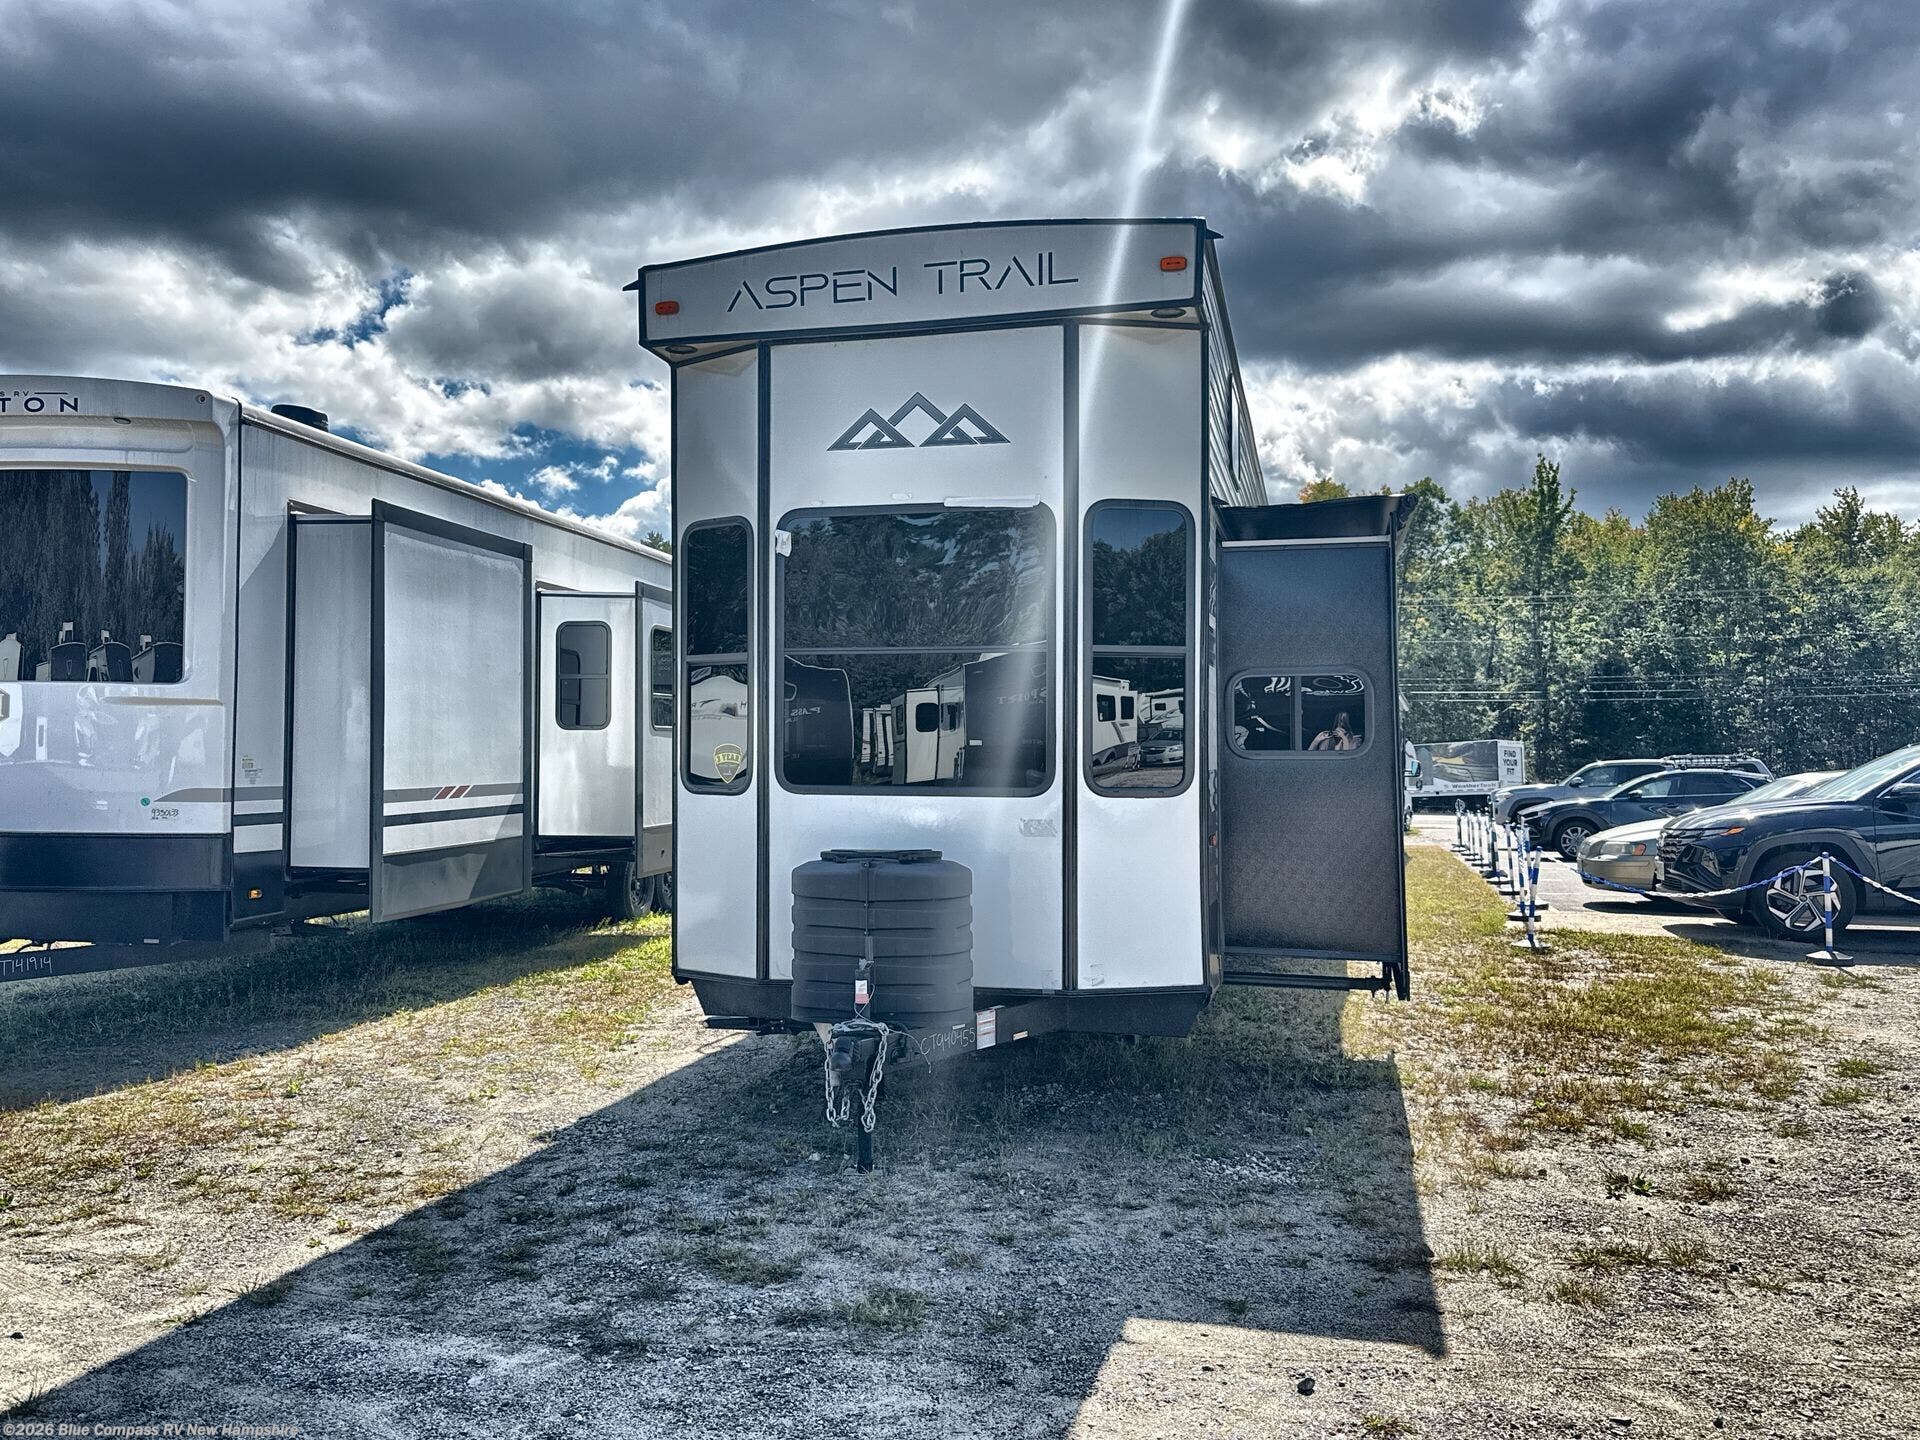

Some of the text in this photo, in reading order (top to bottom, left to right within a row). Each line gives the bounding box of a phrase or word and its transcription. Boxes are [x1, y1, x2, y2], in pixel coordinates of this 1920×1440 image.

[727, 251, 1079, 313] ASPEN TRAIL
[722, 753, 740, 762] YEAR
[1503, 750, 1517, 758] FIND
[1502, 759, 1518, 767] YOUR
